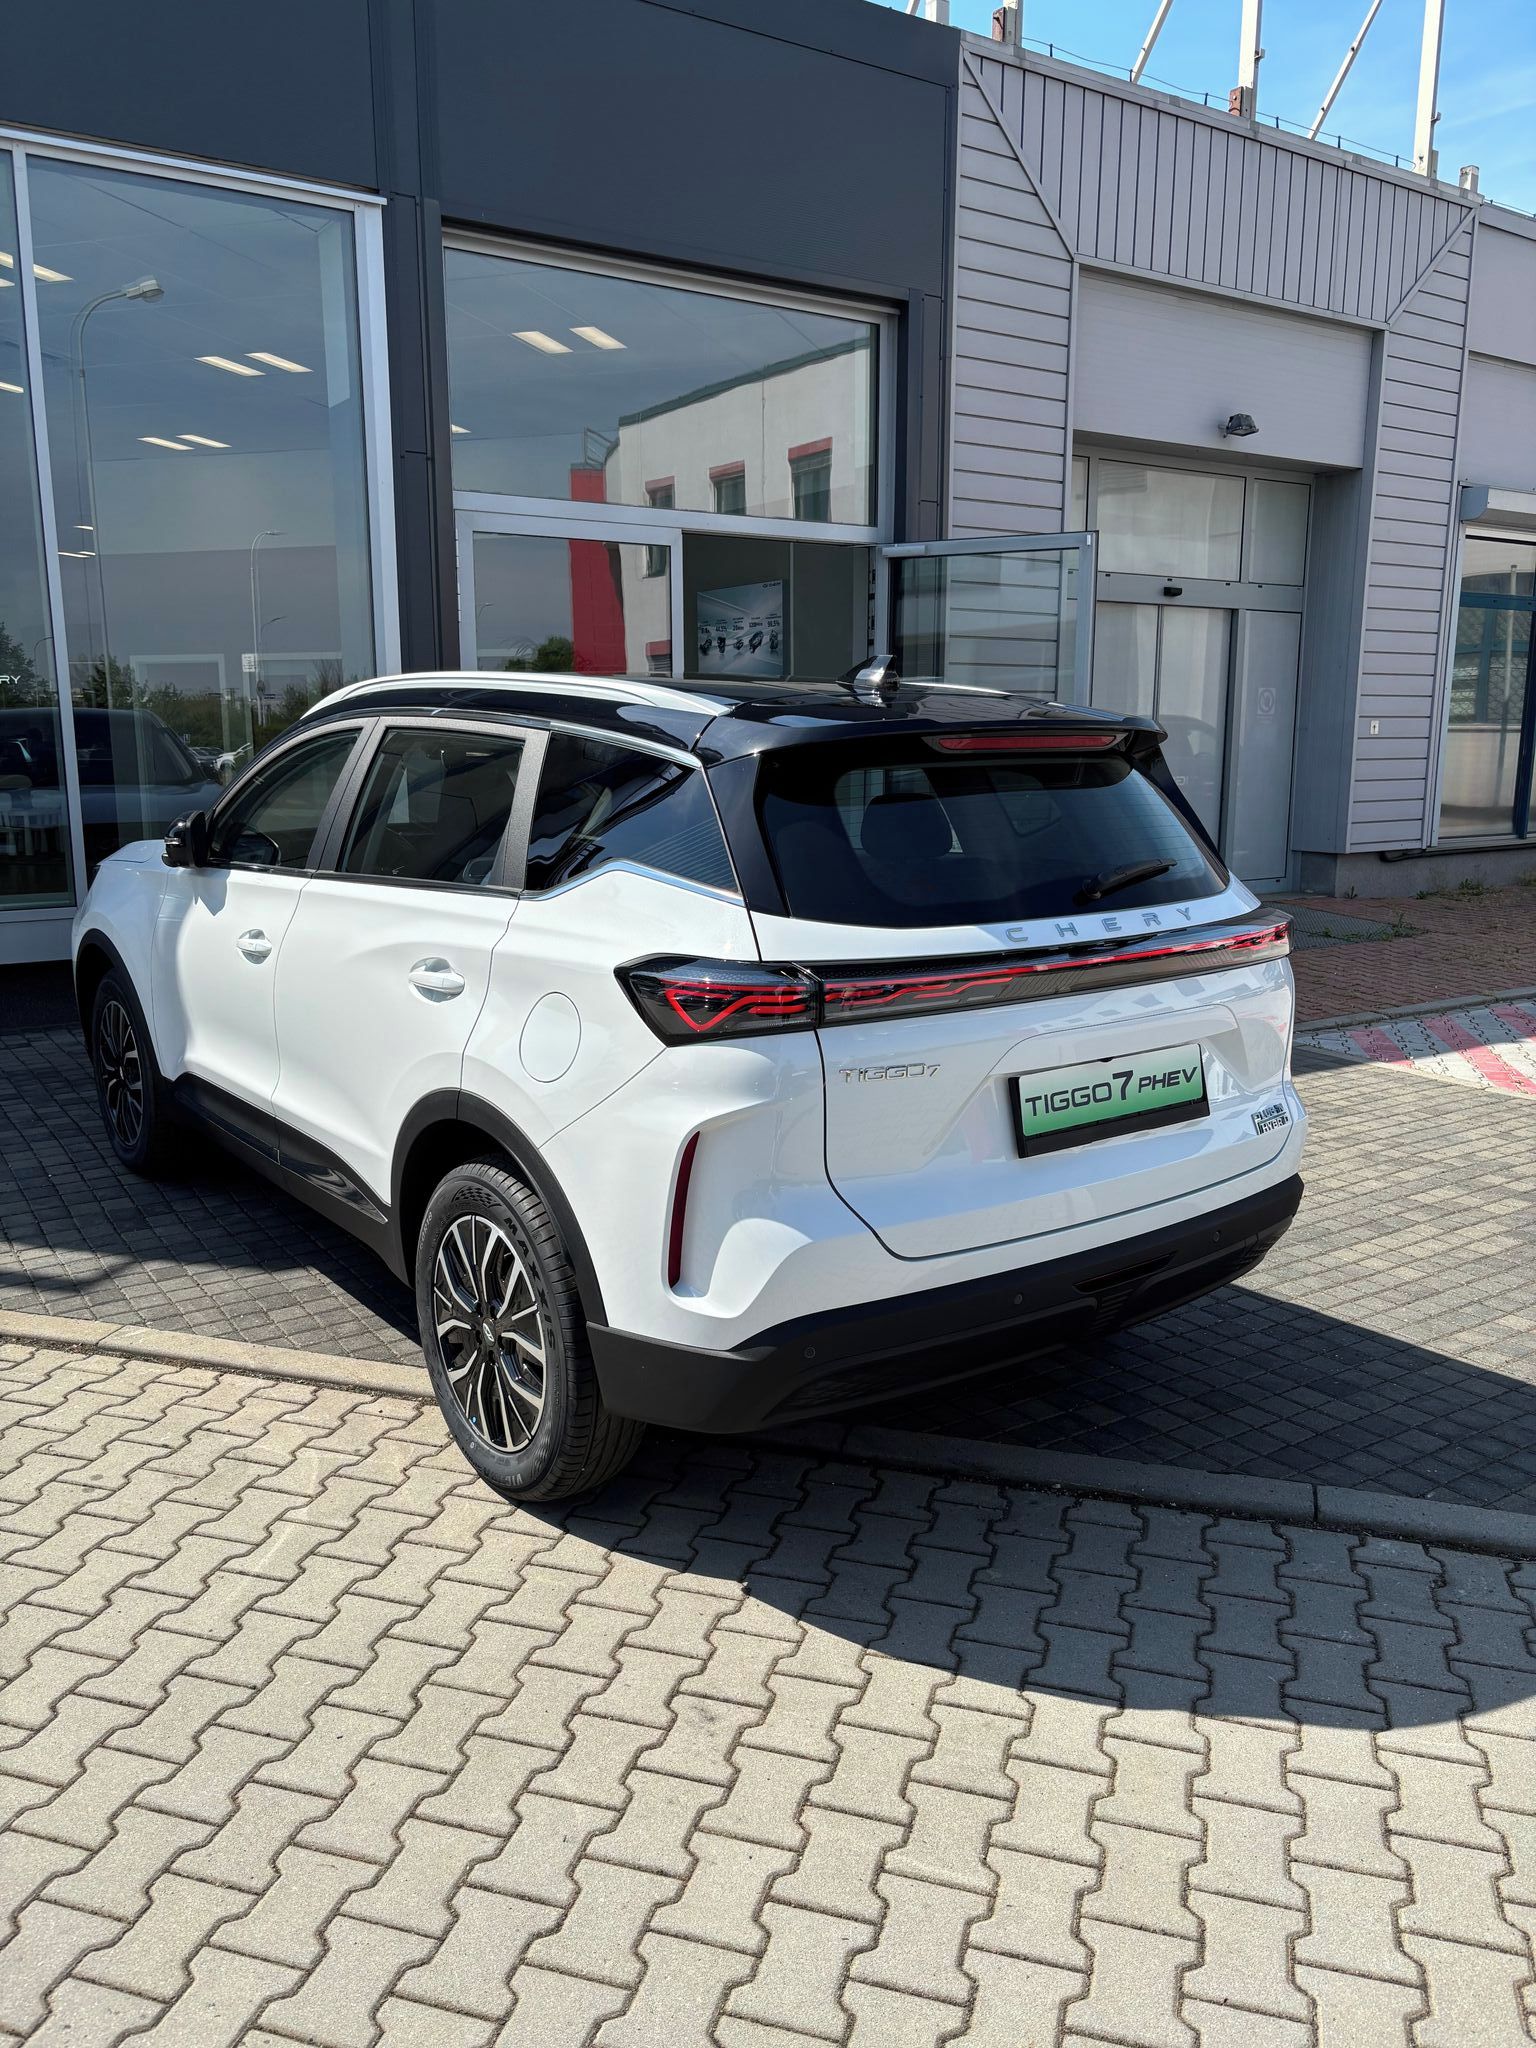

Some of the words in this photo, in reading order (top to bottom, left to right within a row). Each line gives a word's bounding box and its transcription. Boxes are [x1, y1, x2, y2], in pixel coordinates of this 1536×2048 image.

[1005, 907, 1192, 943] CHERY
[1138, 1066, 1198, 1094] PHEV
[504, 1217, 556, 1350] MAXXIS
